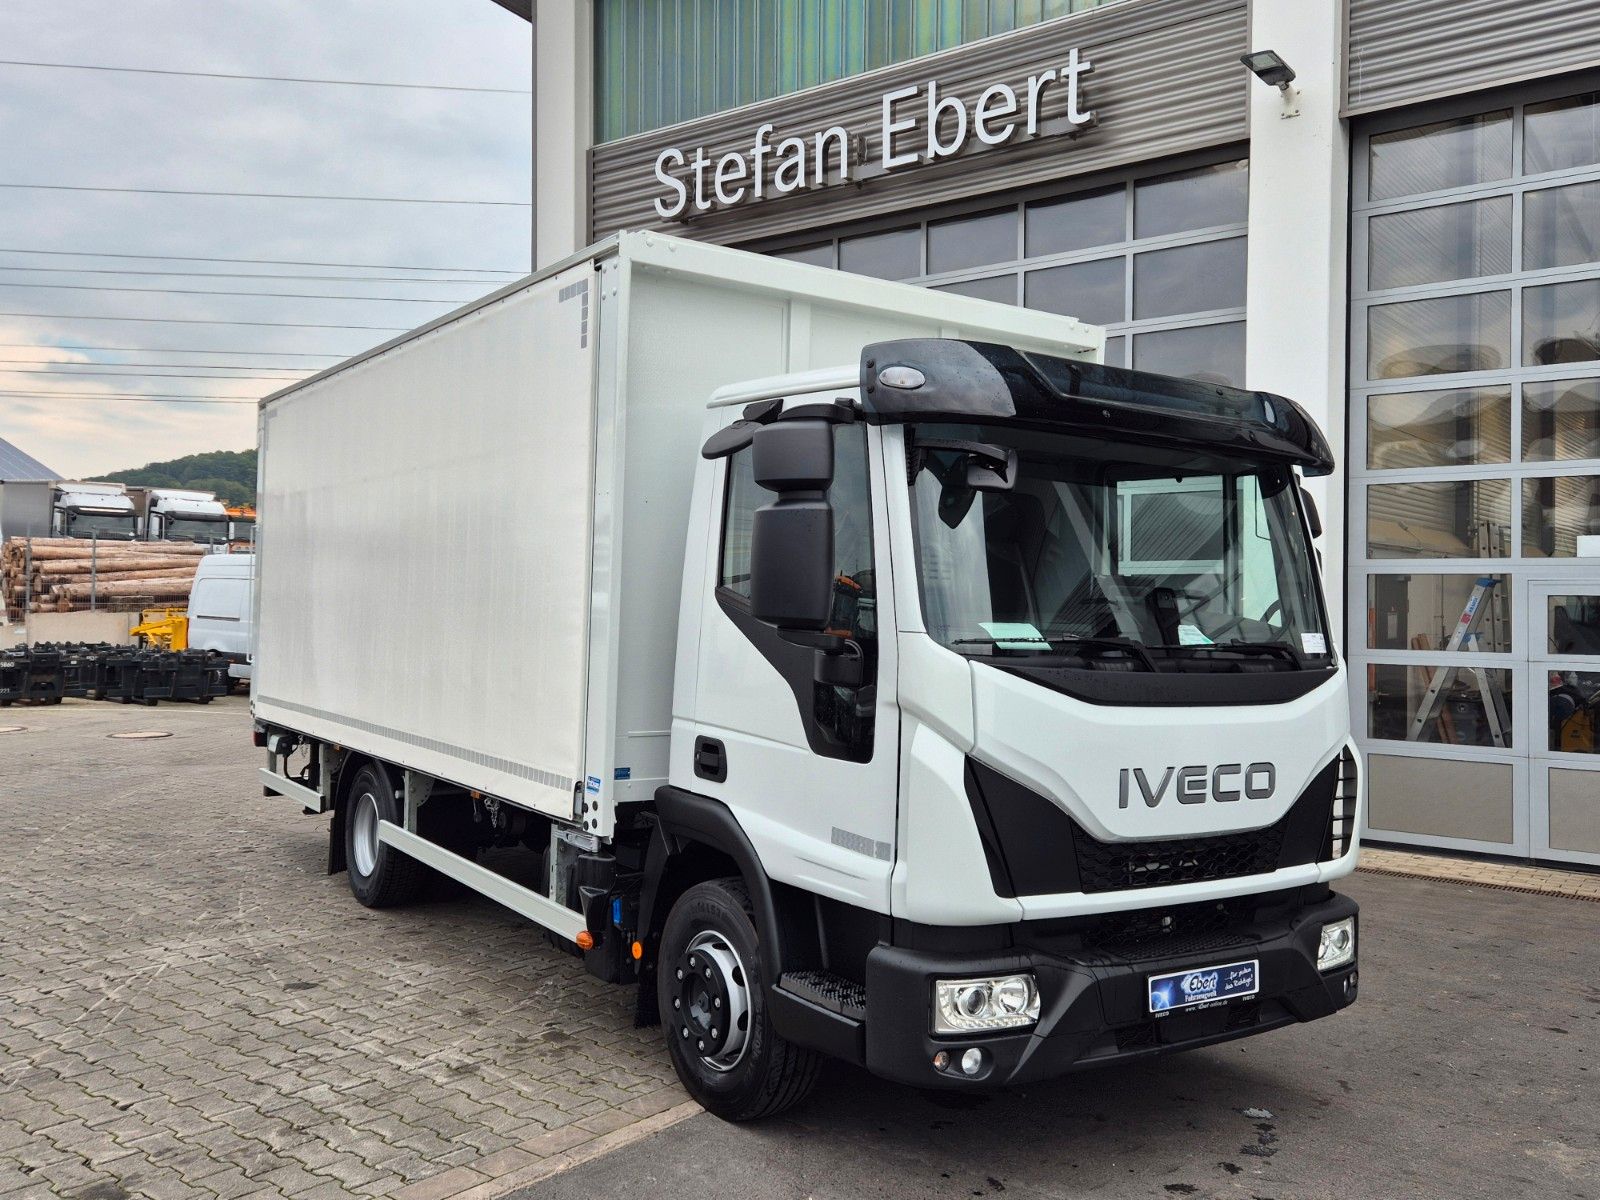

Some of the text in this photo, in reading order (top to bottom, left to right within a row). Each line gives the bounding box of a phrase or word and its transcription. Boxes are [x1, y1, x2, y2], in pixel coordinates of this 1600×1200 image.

[654, 47, 1092, 218] Stefan Ebert
[1119, 762, 1276, 809] IVECO
[1190, 975, 1217, 992] Ebert
